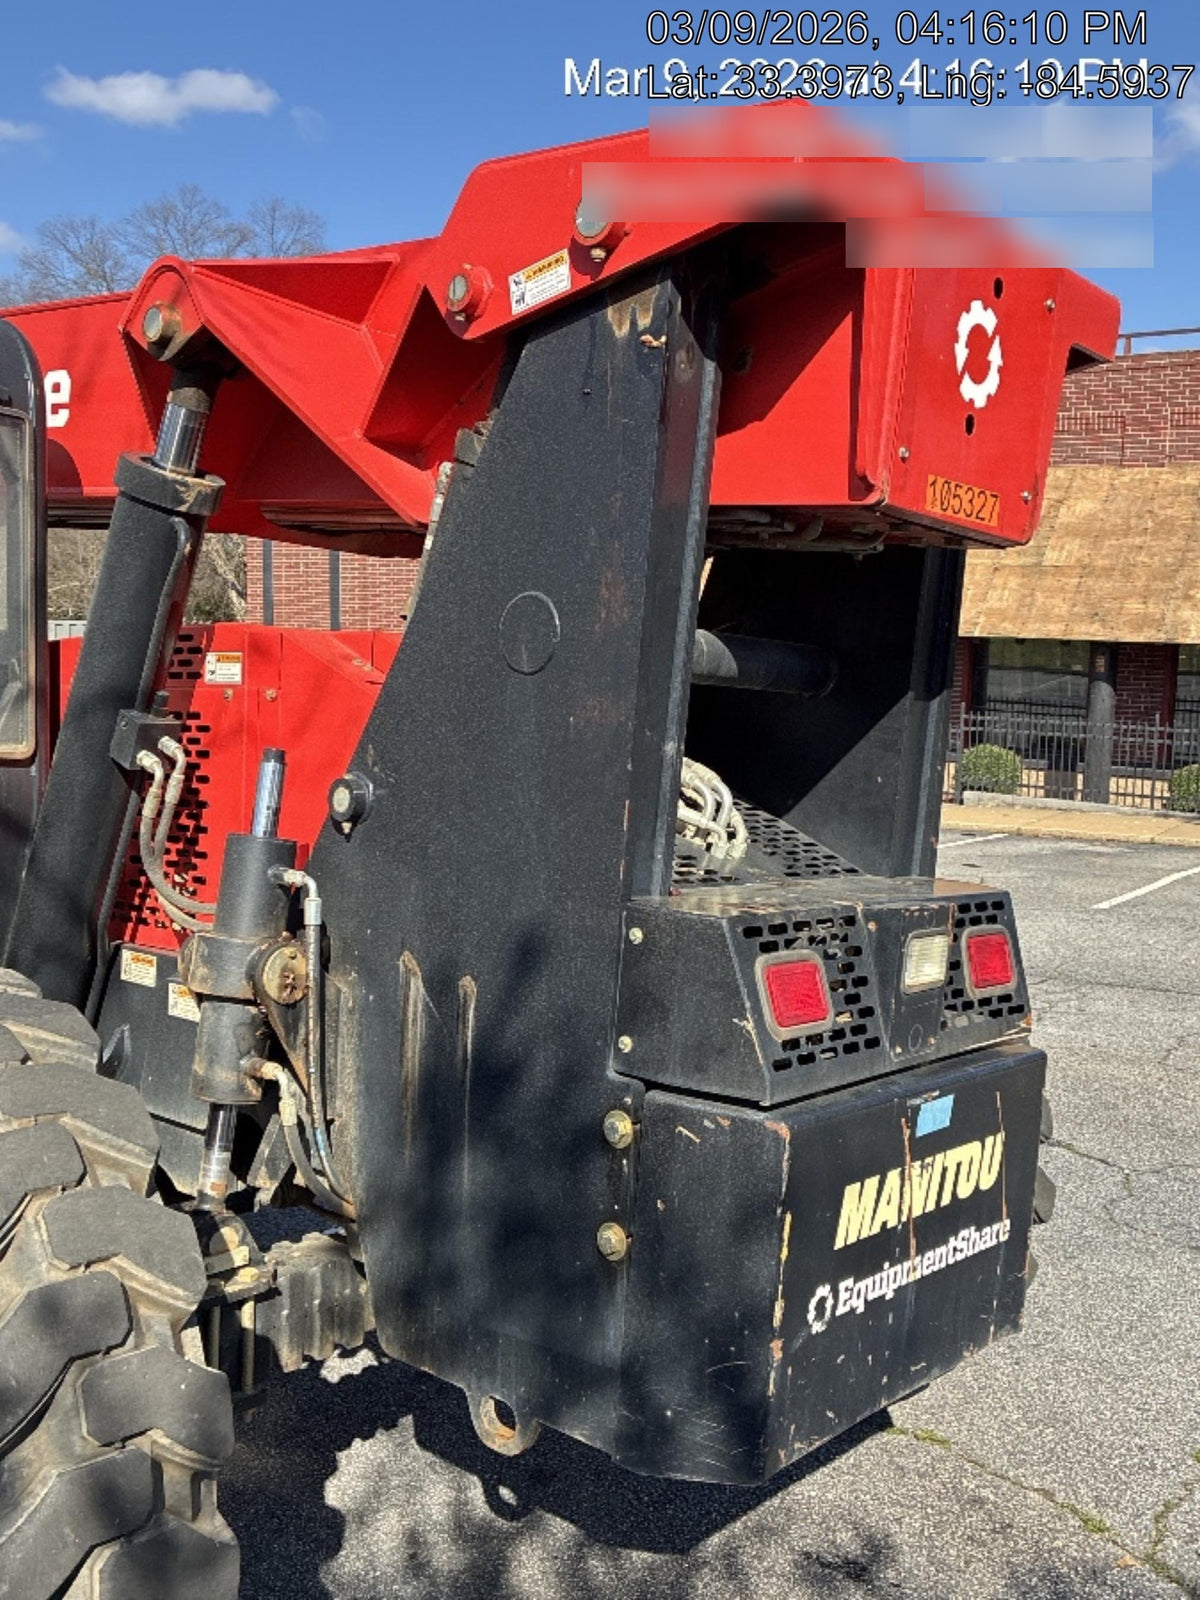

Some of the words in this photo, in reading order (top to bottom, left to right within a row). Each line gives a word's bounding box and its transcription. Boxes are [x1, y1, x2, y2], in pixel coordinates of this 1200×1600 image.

[929, 476, 999, 523] 105327
[834, 1131, 1005, 1251] MANITOU
[835, 1219, 1011, 1314] EquipmentShare
